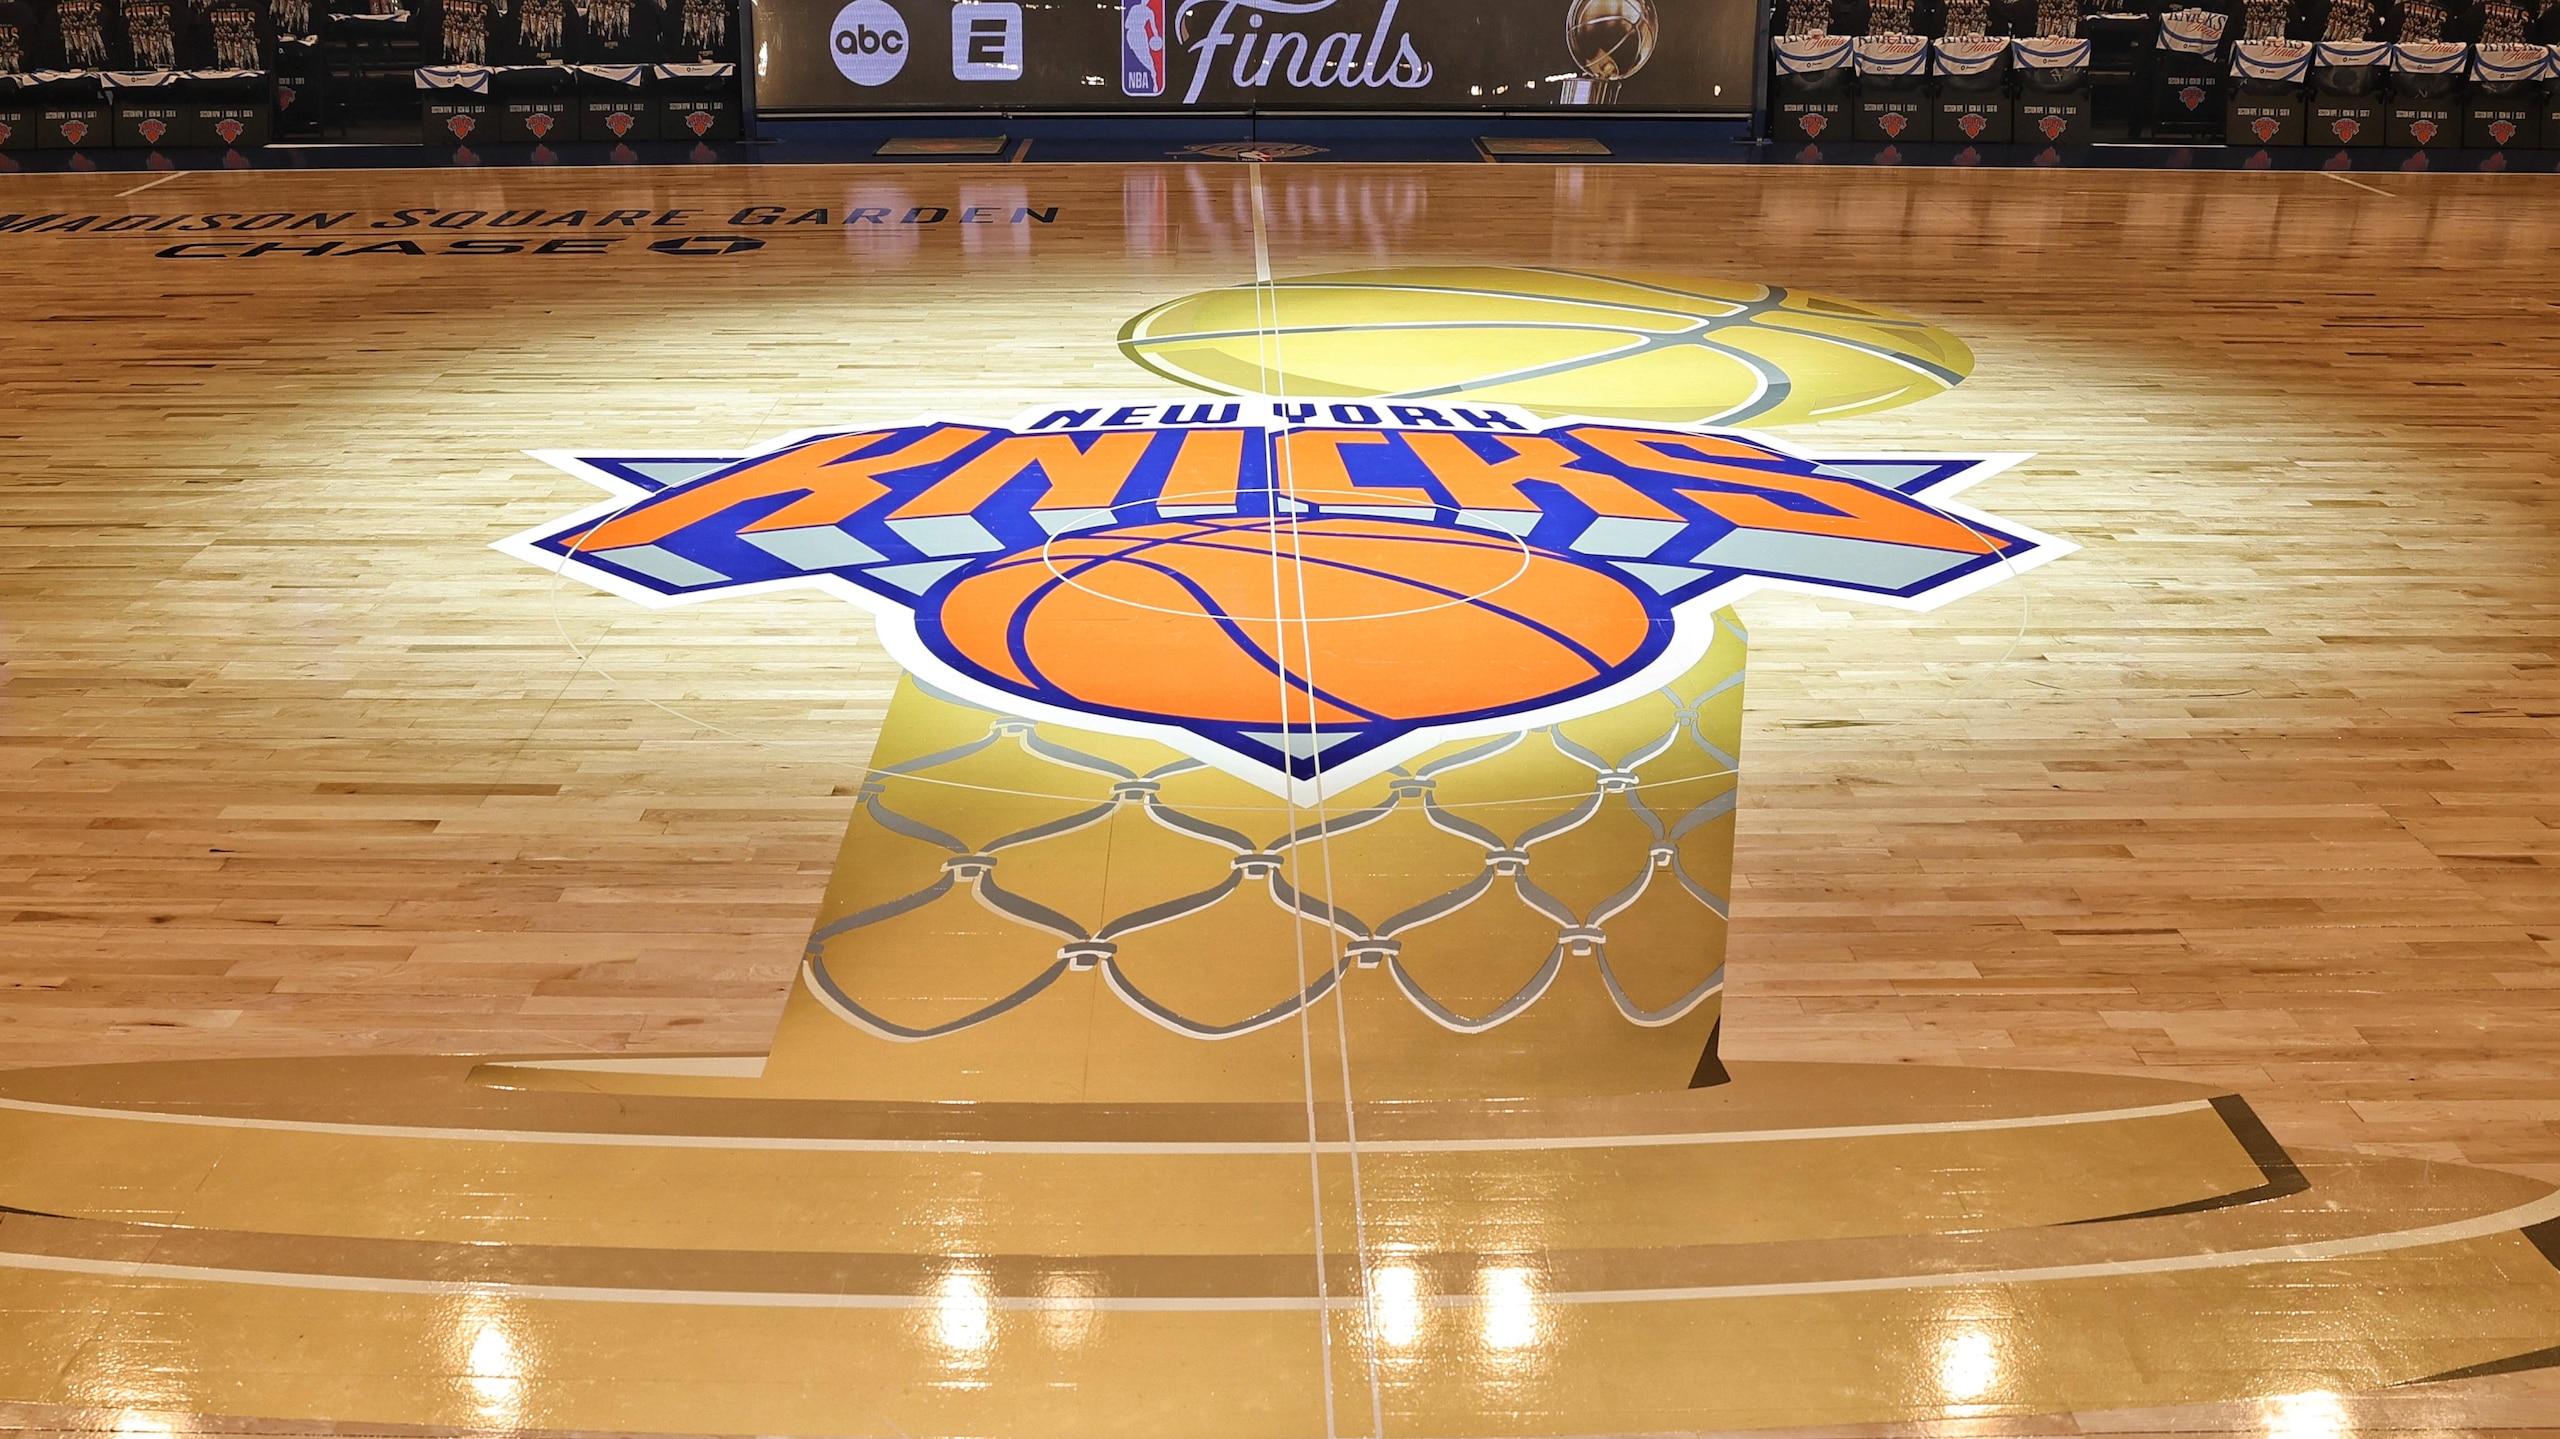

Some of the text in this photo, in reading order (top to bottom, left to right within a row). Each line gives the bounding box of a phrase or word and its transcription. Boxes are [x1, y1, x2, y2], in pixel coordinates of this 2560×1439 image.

[210, 11, 256, 23] FINALS
[835, 23, 904, 55] abc
[1175, 0, 1433, 104] Finals
[1128, 71, 1149, 89] NBA
[0, 206, 1060, 233] MADISON SQUARE GARDEN
[154, 236, 625, 259] CHASE
[1027, 403, 1529, 431] NEW YORK
[556, 426, 2012, 555] KNICKS
